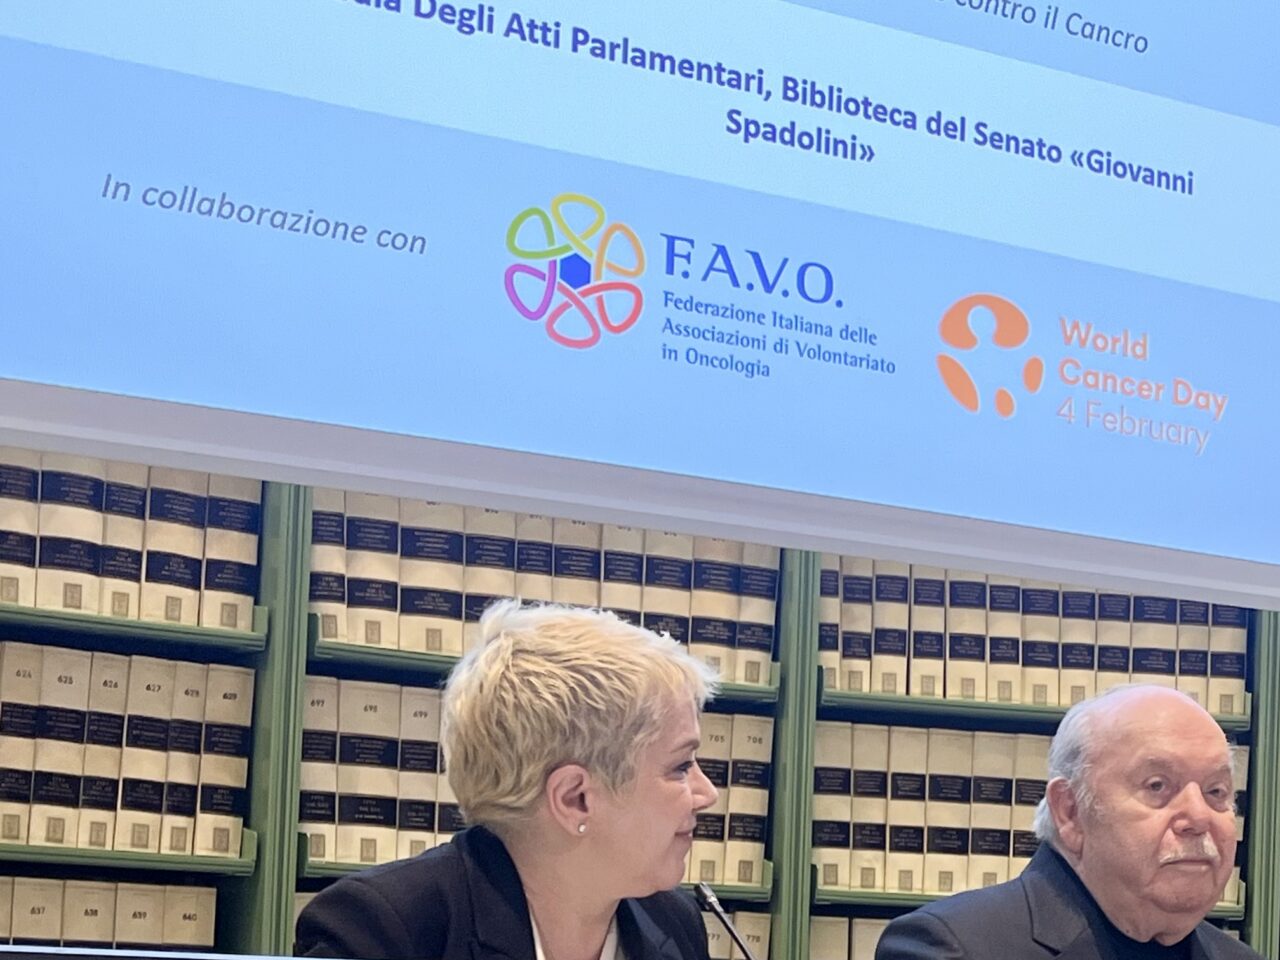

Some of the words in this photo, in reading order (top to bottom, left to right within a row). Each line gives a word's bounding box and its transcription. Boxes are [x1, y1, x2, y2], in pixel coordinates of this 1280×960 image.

[1043, 6, 1059, 30] il
[1065, 13, 1149, 54] Cancro
[414, 0, 495, 35] Degli
[503, 13, 561, 49] Atti
[571, 27, 772, 101] Parlamentari,
[782, 76, 917, 131] Biblioteca
[926, 110, 966, 143] del
[973, 122, 1063, 164] Senato
[1071, 149, 1194, 196] «Giovanni
[725, 108, 876, 164] Spadolini»
[102, 173, 131, 202] In
[141, 185, 368, 244] collaborazione
[376, 229, 427, 255] con
[660, 233, 844, 309] F.A.V.O.
[662, 317, 767, 351] Associazioni
[773, 338, 789, 355] di
[795, 341, 897, 375] Volontariato
[663, 290, 767, 326] Federazione
[772, 311, 833, 338] Italiana
[839, 325, 878, 346] delle
[1059, 317, 1148, 361] World
[662, 344, 678, 362] in
[686, 348, 771, 379] Oncologia
[1058, 357, 1165, 401] Cancer
[1172, 378, 1229, 423] Day
[1056, 397, 1075, 425] 4
[1086, 400, 1210, 456] February
